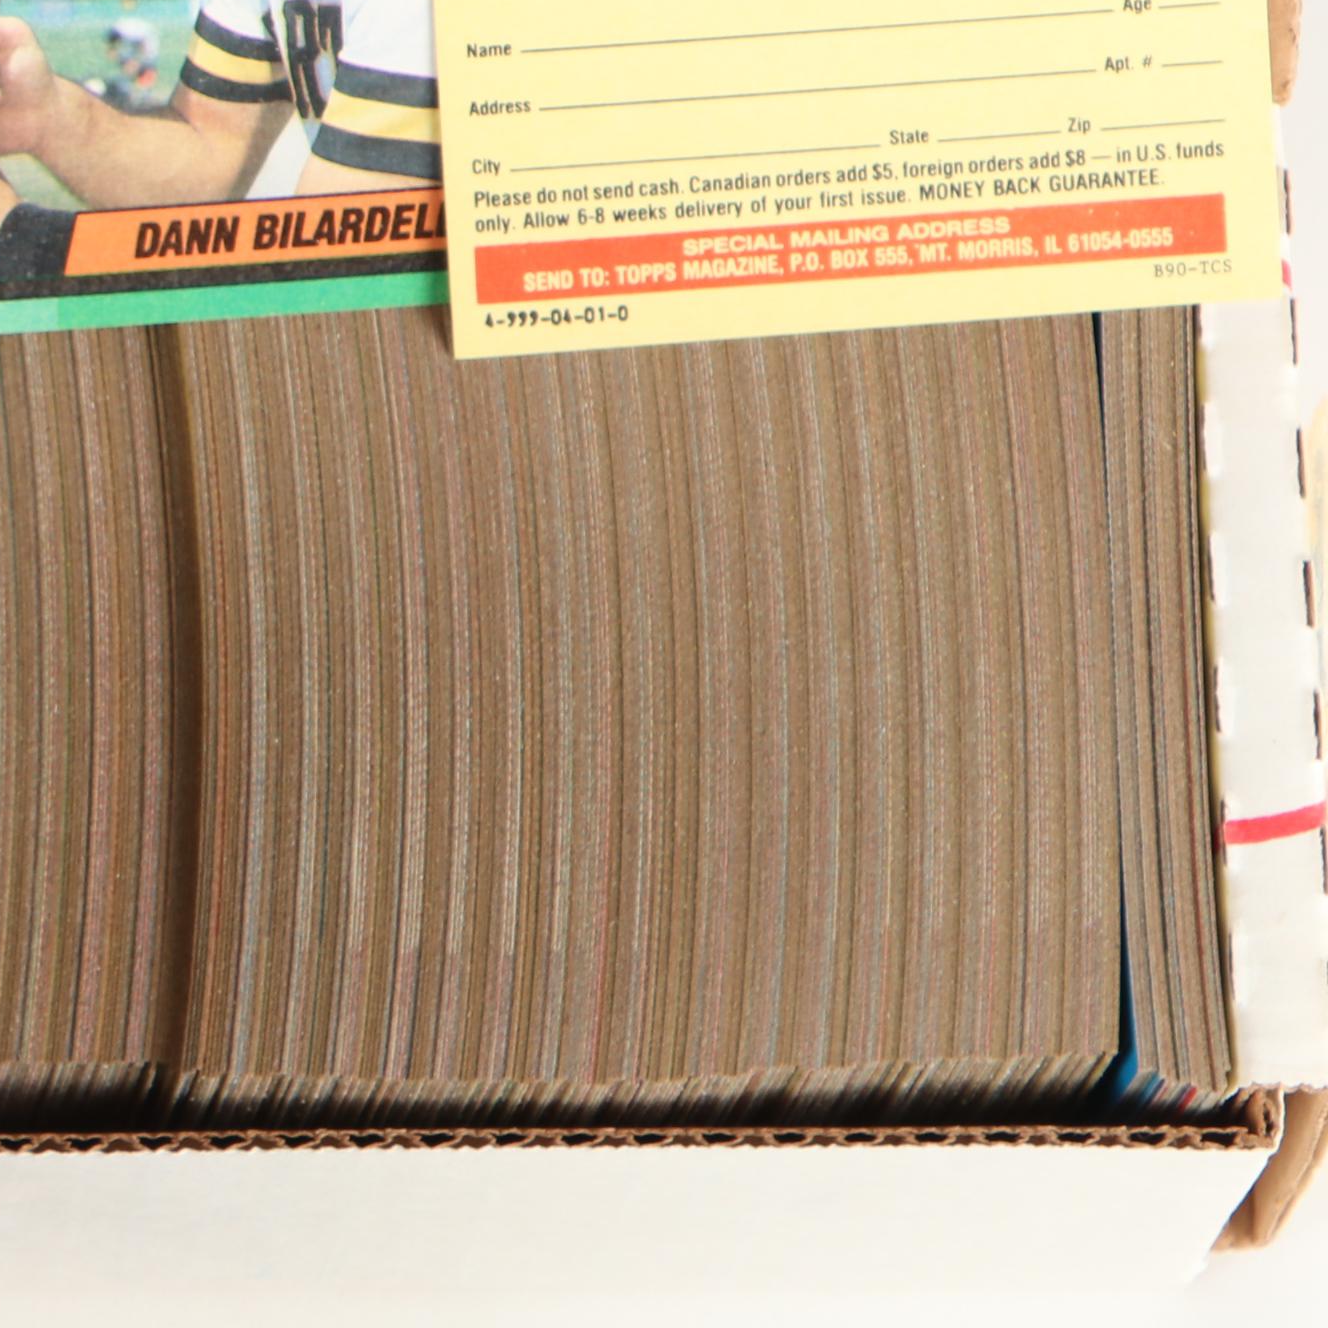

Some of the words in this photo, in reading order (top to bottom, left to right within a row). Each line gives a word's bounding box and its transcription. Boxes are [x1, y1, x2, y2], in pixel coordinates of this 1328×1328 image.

[466, 43, 512, 58] Name
[1104, 55, 1134, 75] Apt.
[469, 100, 532, 117] Address
[1067, 116, 1092, 136] Zip
[889, 129, 930, 146] State
[471, 158, 501, 177] City
[134, 216, 240, 259] DANN
[683, 234, 784, 256] SPECIAL
[790, 224, 890, 248] MAILING
[896, 216, 1011, 241] ADDRESS
[523, 269, 574, 292] SEND
[579, 267, 609, 287] TO:
[615, 262, 677, 285] TOPPS
[682, 254, 784, 280] MAGAZINE,
[789, 251, 825, 272] P.O.
[830, 248, 869, 270] BOX
[874, 245, 913, 267] 555,
[920, 242, 951, 263] MT.
[957, 236, 1039, 261] MORRIS,
[1044, 234, 1063, 254] IL
[1067, 226, 1174, 253] 61054-0555
[1151, 257, 1233, 281] B90-TCS
